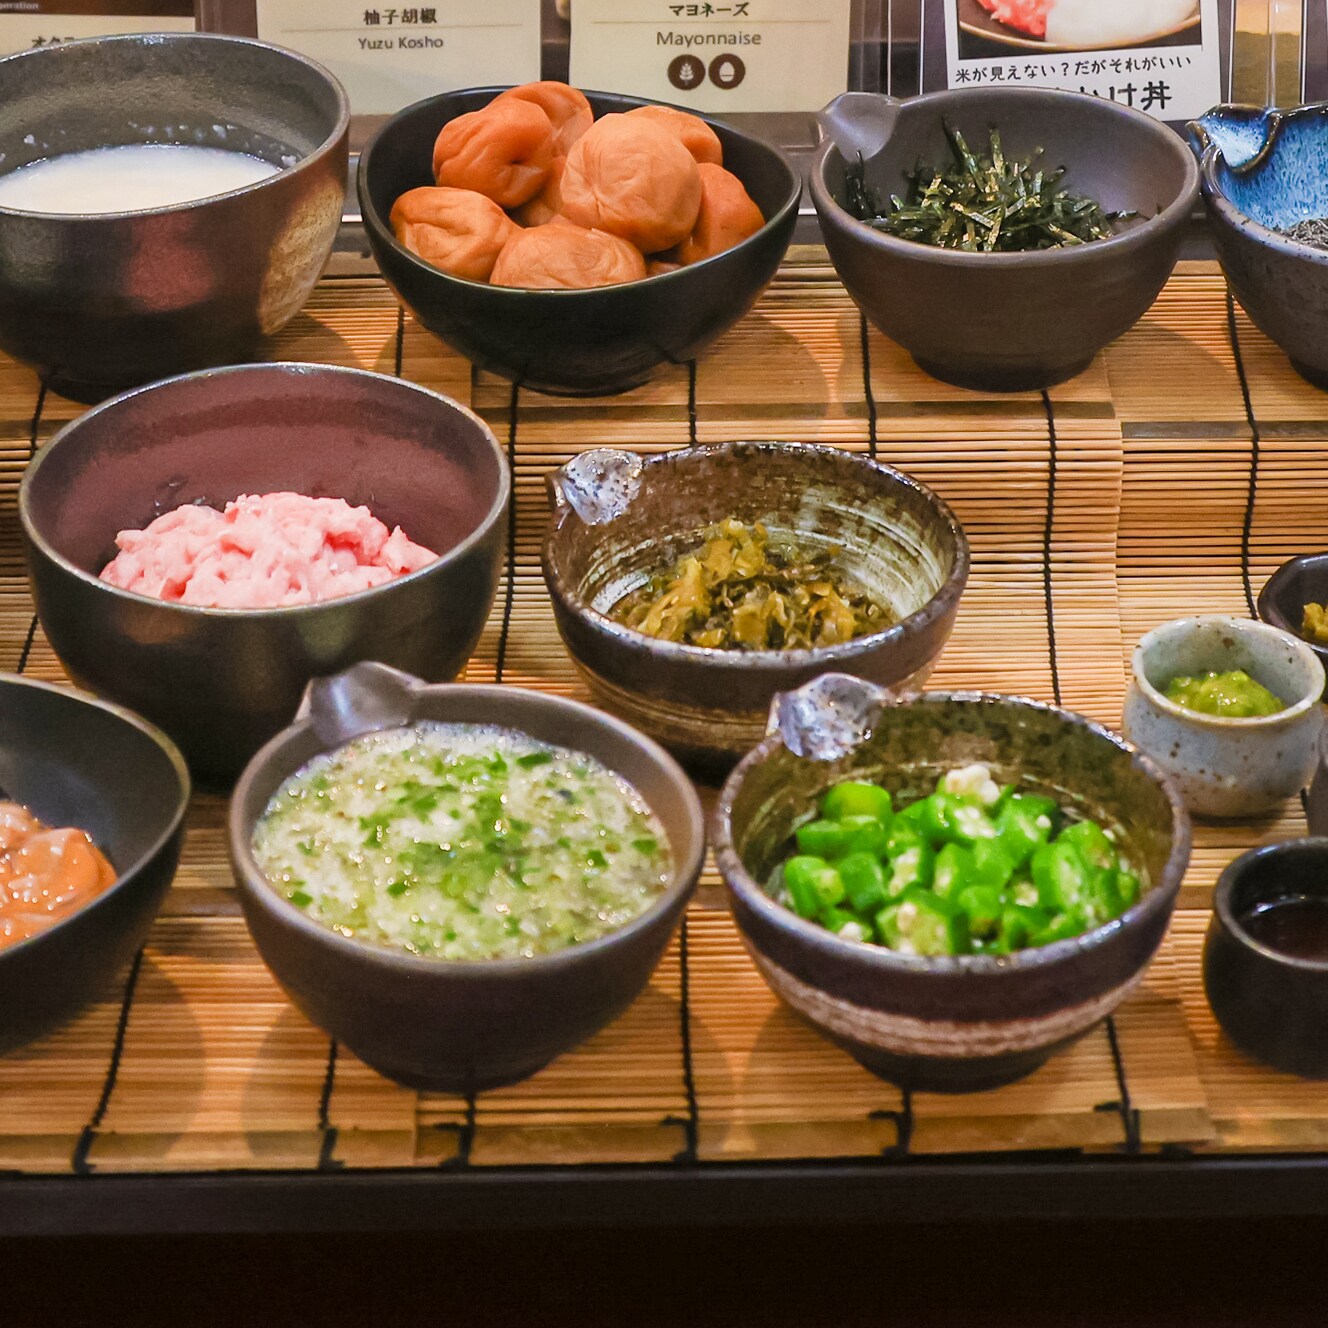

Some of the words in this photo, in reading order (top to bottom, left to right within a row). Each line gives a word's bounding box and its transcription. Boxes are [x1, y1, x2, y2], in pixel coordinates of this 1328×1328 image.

[364, 9, 437, 25] 柚子胡椒
[669, 2, 749, 17] マヨネーズ
[358, 38, 393, 49] Yuzu
[399, 36, 443, 48] Kosho
[657, 32, 761, 47] Mayonnaise
